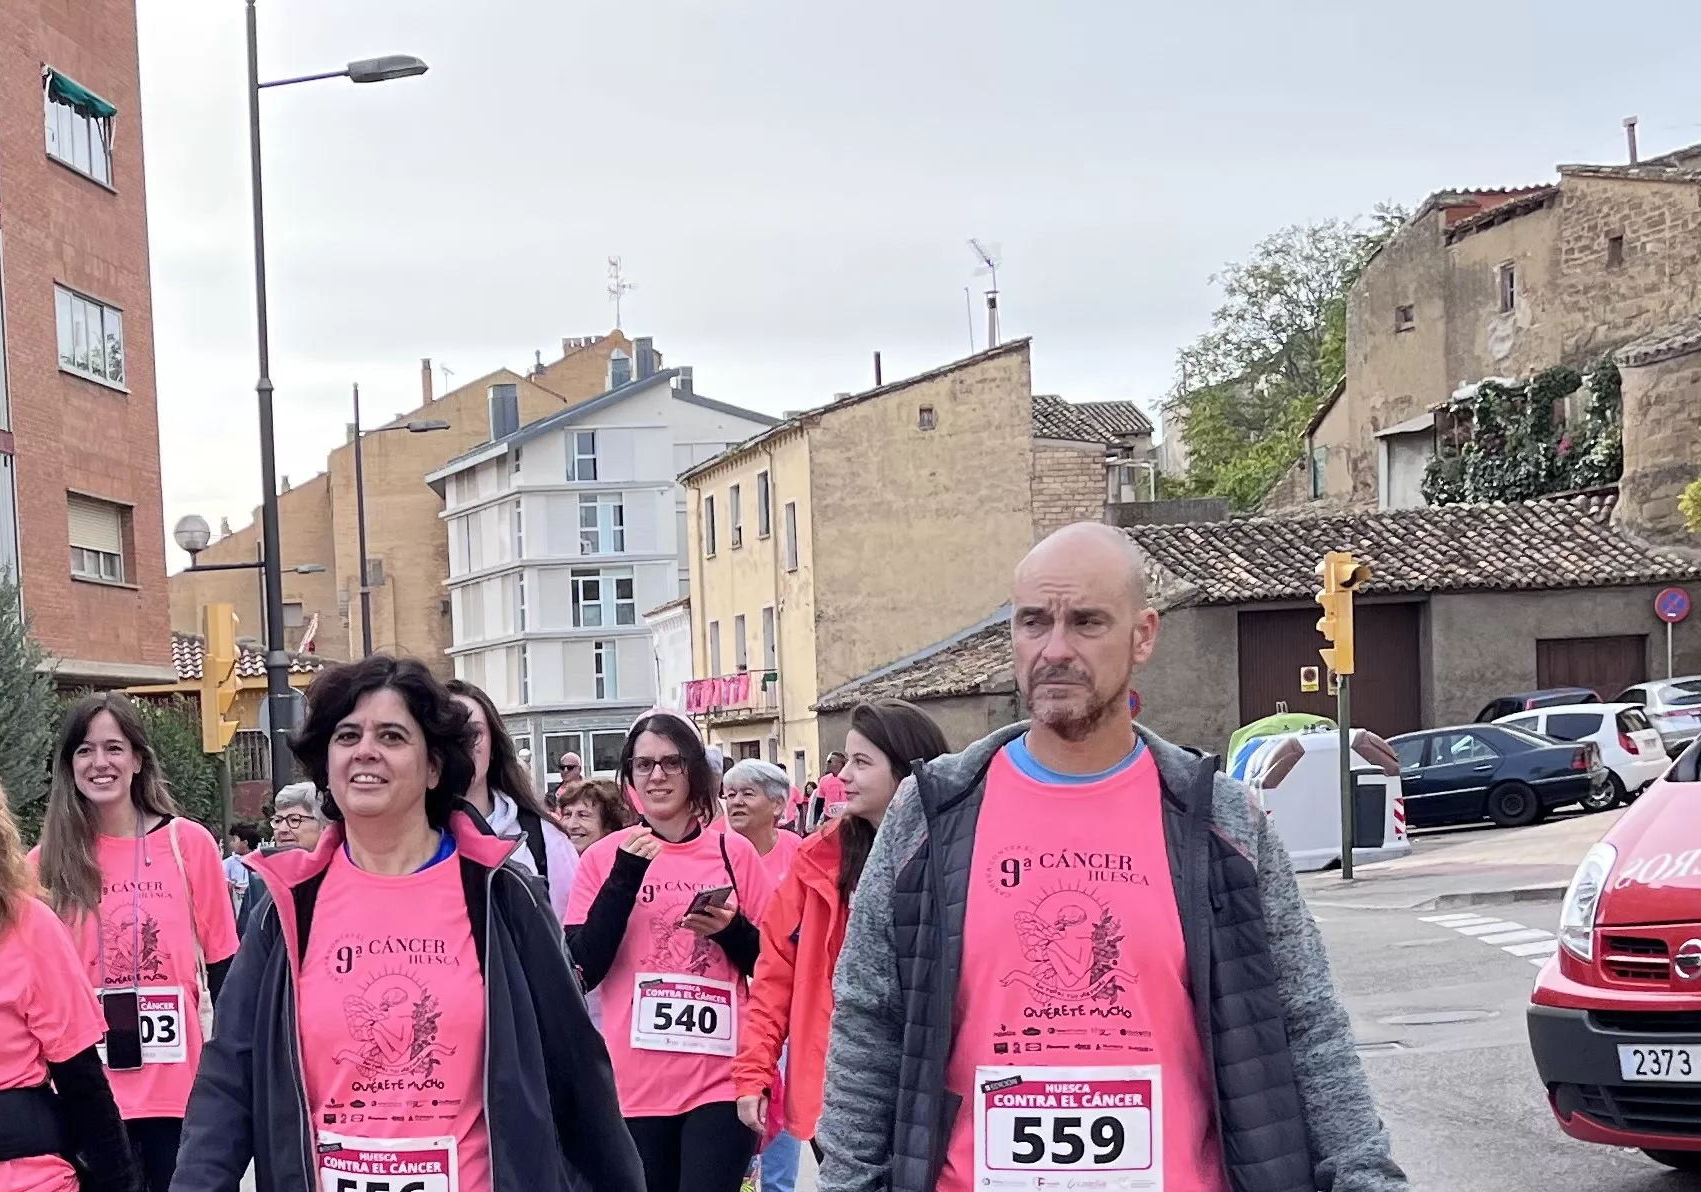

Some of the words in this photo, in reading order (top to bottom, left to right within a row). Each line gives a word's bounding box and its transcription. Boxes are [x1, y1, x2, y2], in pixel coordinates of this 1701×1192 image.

[1039, 848, 1132, 870] CÁNCER
[1088, 870, 1149, 885] HUESCA
[369, 935, 445, 954] CÁNCER
[409, 954, 460, 966] HUESCA
[675, 983, 701, 992] HUESCA
[645, 988, 682, 998] CONTRA
[684, 990, 694, 999] EL
[695, 991, 727, 1004] CÁNCER
[140, 1000, 175, 1010] CÁNCER
[1090, 1005, 1132, 1019] MUCHO
[653, 1002, 717, 1034] 540
[1633, 1049, 1692, 1076] 2373
[407, 1079, 445, 1091] MUCHO
[1045, 1083, 1090, 1093] HUESCA
[993, 1094, 1058, 1108] CONTRA
[1060, 1095, 1078, 1108] EL
[1081, 1091, 1143, 1108] CÁNCER
[1012, 1116, 1125, 1164] 559
[323, 1156, 369, 1173] CONTRA
[372, 1163, 387, 1173] EL
[390, 1161, 442, 1174] CÁNCER
[359, 1153, 397, 1162] HUESCA
